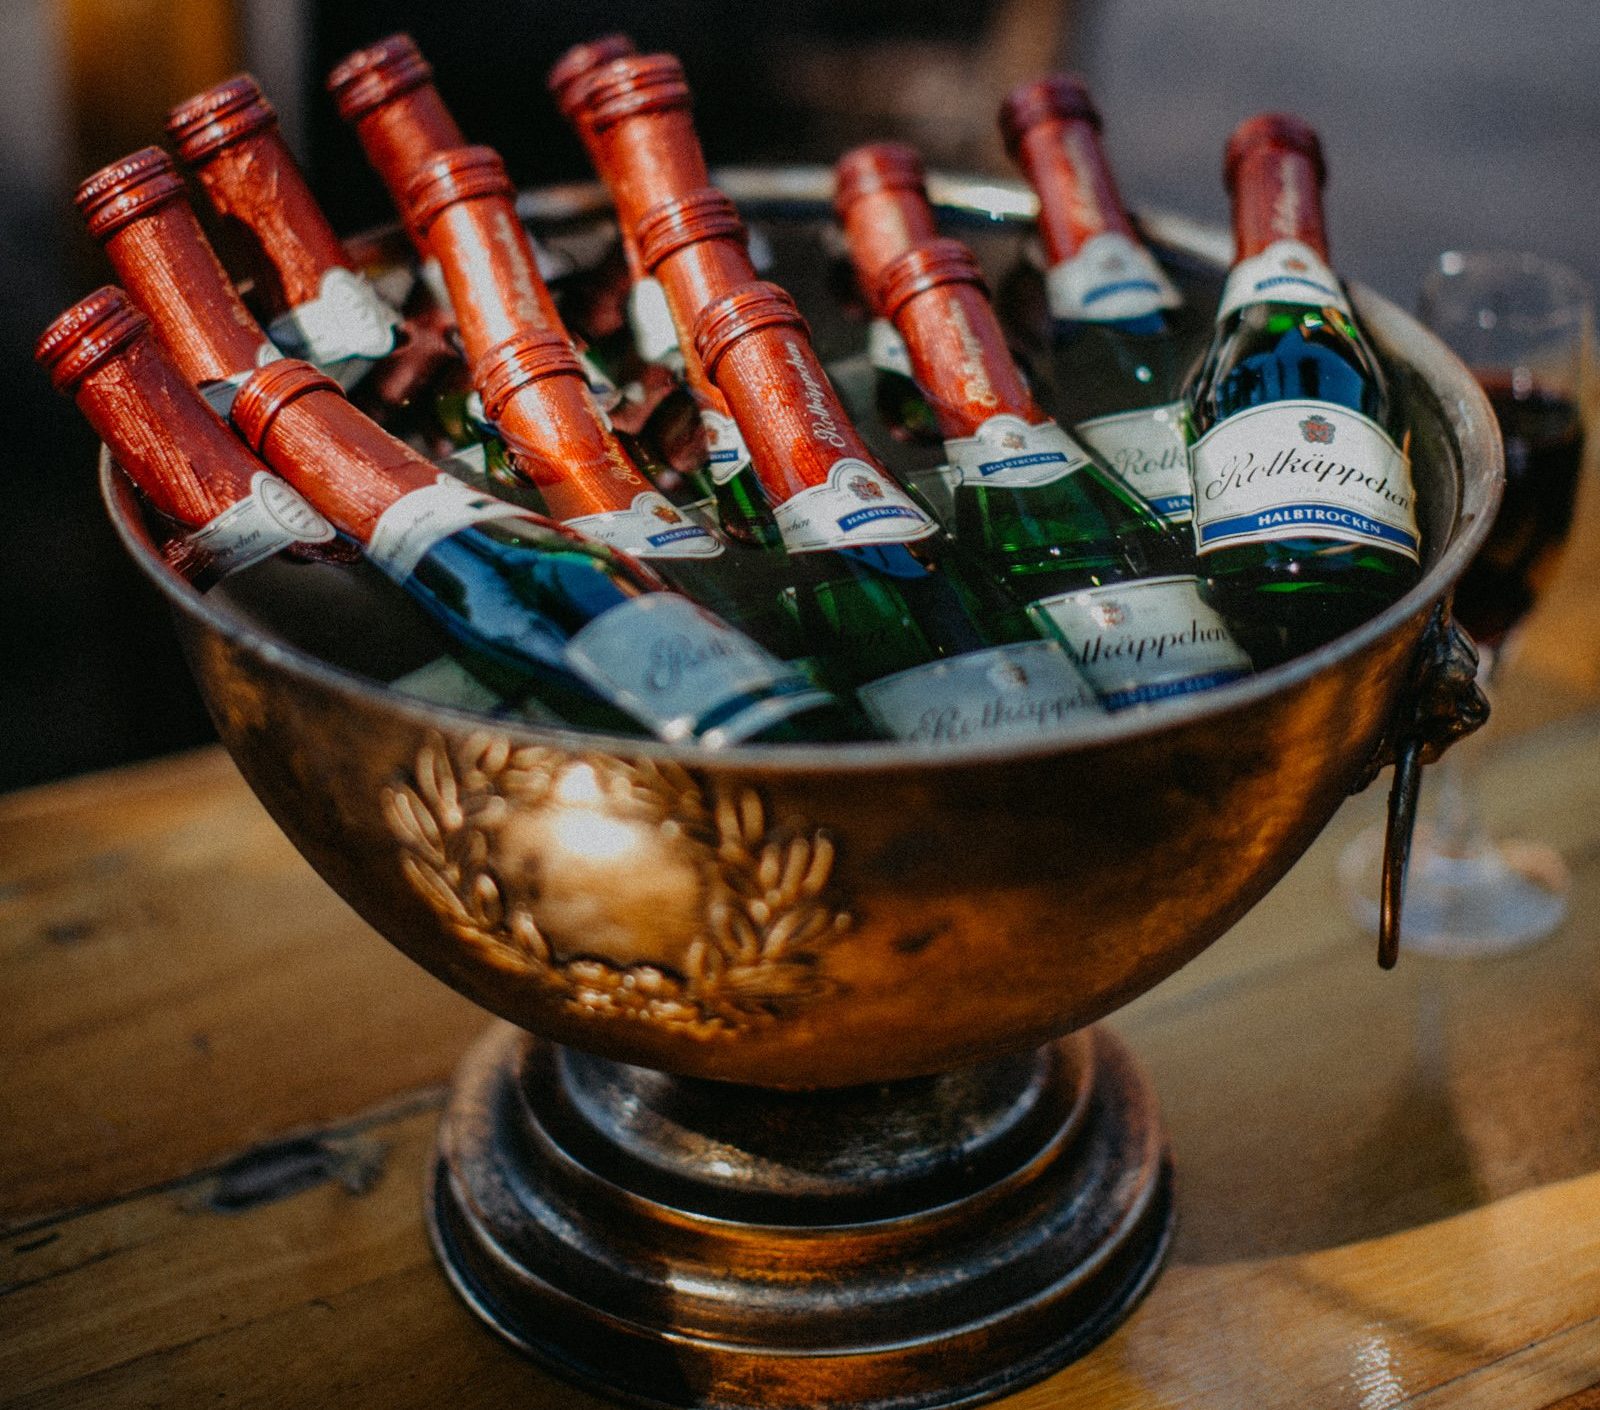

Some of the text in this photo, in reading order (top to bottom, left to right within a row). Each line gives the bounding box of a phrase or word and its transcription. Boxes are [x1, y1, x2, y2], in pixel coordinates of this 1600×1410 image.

[985, 454, 1061, 473] HALBTROCKEN
[1205, 447, 1409, 510] Rotkäppchen
[1257, 508, 1382, 535] HALBTROCKEN
